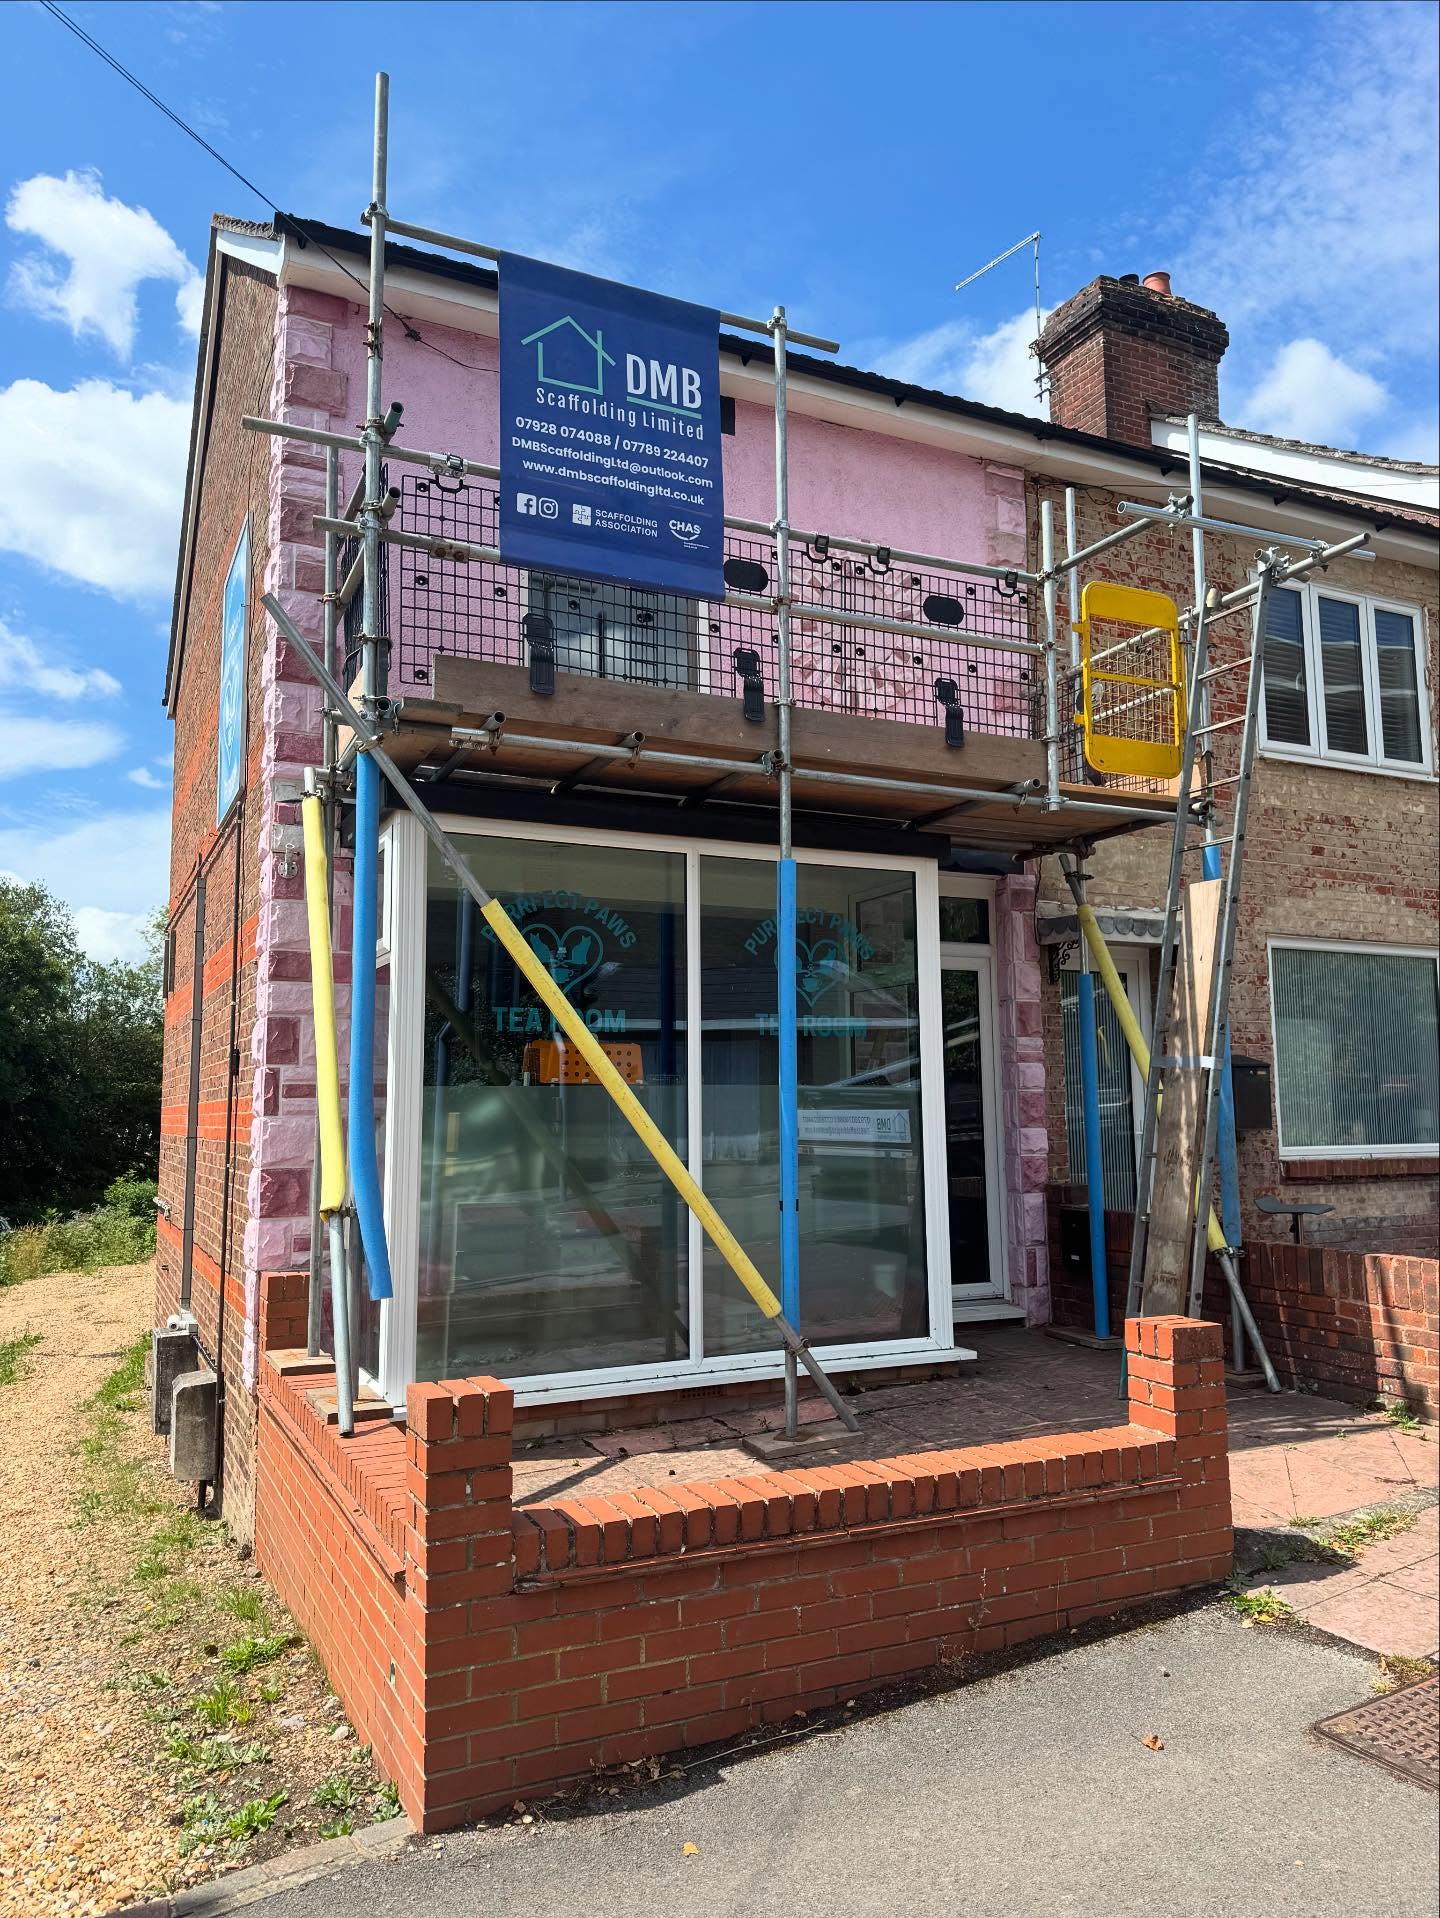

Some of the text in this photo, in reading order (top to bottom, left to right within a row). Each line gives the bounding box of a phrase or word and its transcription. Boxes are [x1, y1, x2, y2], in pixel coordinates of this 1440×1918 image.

[626, 353, 702, 409] DMB
[536, 387, 704, 441] Scaffolding Limited
[512, 437, 713, 489] DMBScaffoldingLtd@outlook.com
[515, 416, 709, 468] 07928 074088 / 07789 224407
[522, 460, 705, 506] www.dmbscaffoldingltd.co.uk
[595, 509, 658, 528] SCAFFOLDING
[595, 519, 658, 538] ASSOCIATION
[668, 519, 702, 534] CHAS
[480, 889, 637, 948] PRRFECT PAWS
[744, 908, 825, 955] PURECT
[491, 1006, 626, 1033] TEA OM
[802, 1014, 868, 1037] ROOM
